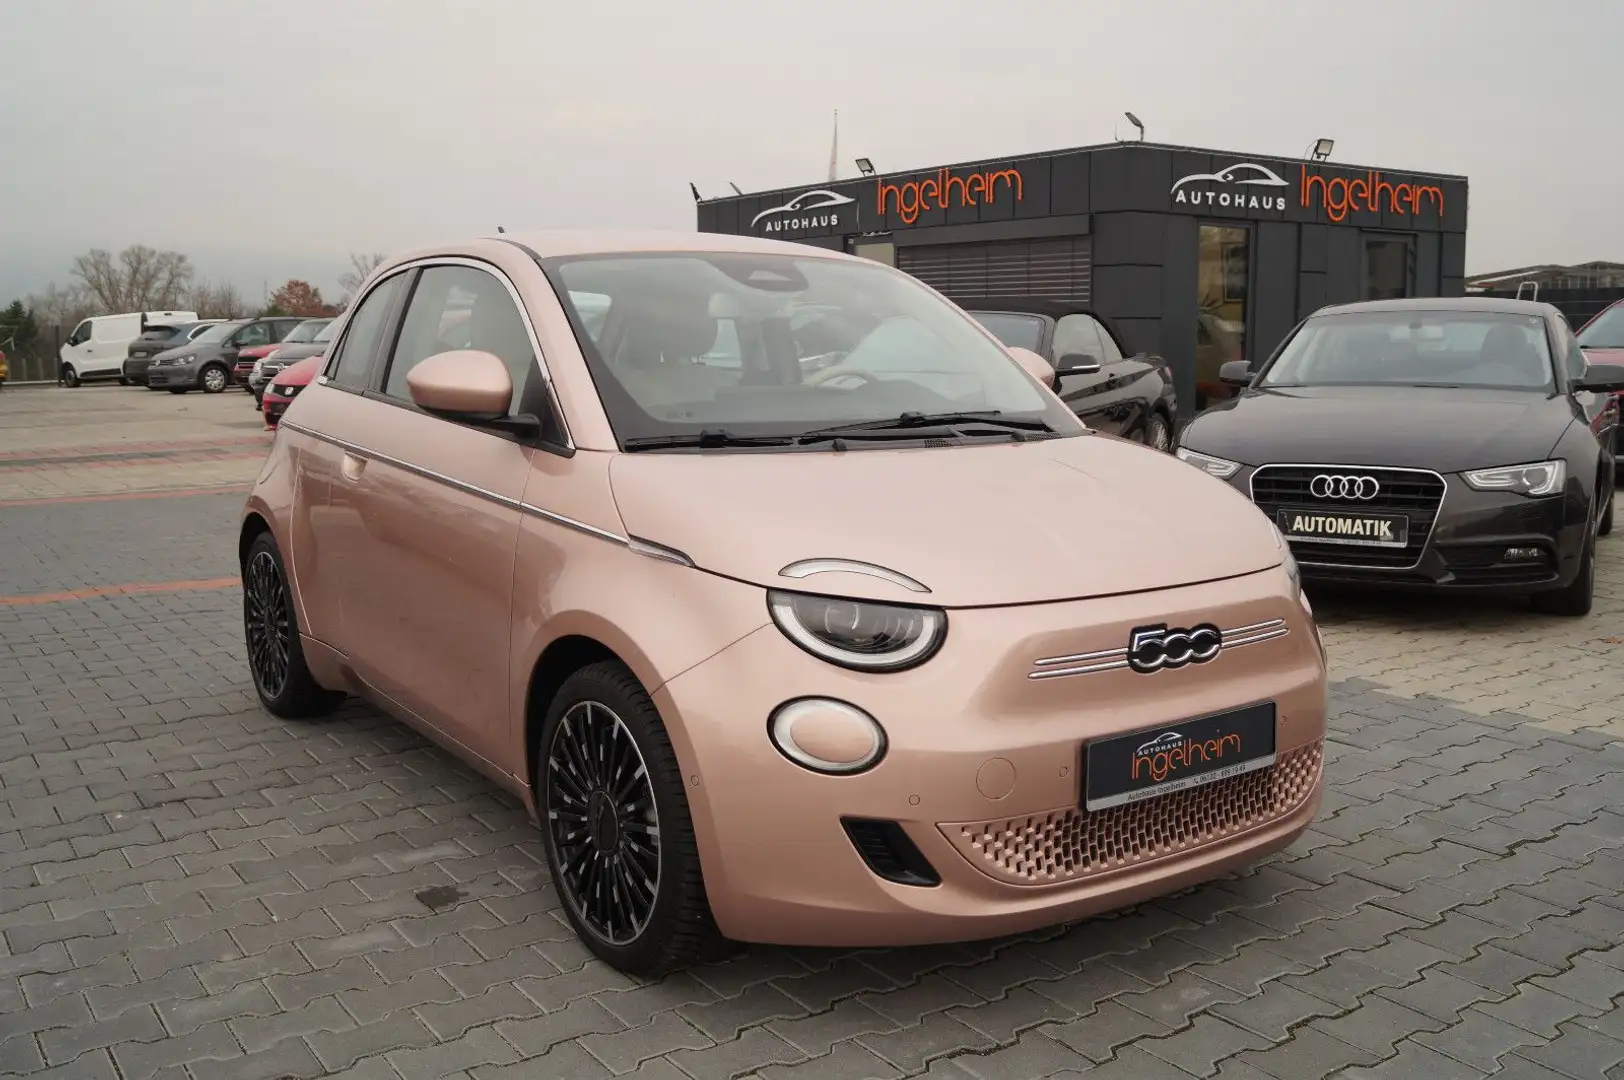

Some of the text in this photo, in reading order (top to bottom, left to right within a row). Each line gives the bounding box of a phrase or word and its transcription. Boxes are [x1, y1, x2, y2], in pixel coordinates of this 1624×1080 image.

[765, 167, 1023, 232] AUTOHAUS Ingelheim
[1175, 163, 1444, 222] AUTOHAUS Ingelheim
[1292, 516, 1392, 537] AUTOMATIK
[1127, 623, 1222, 674] 500
[1131, 735, 1241, 782] Ingelheim
[1138, 741, 1183, 756] AUTOHAUS
[1127, 787, 1156, 801] Autohaus
[1157, 781, 1186, 794] Ingelheim
